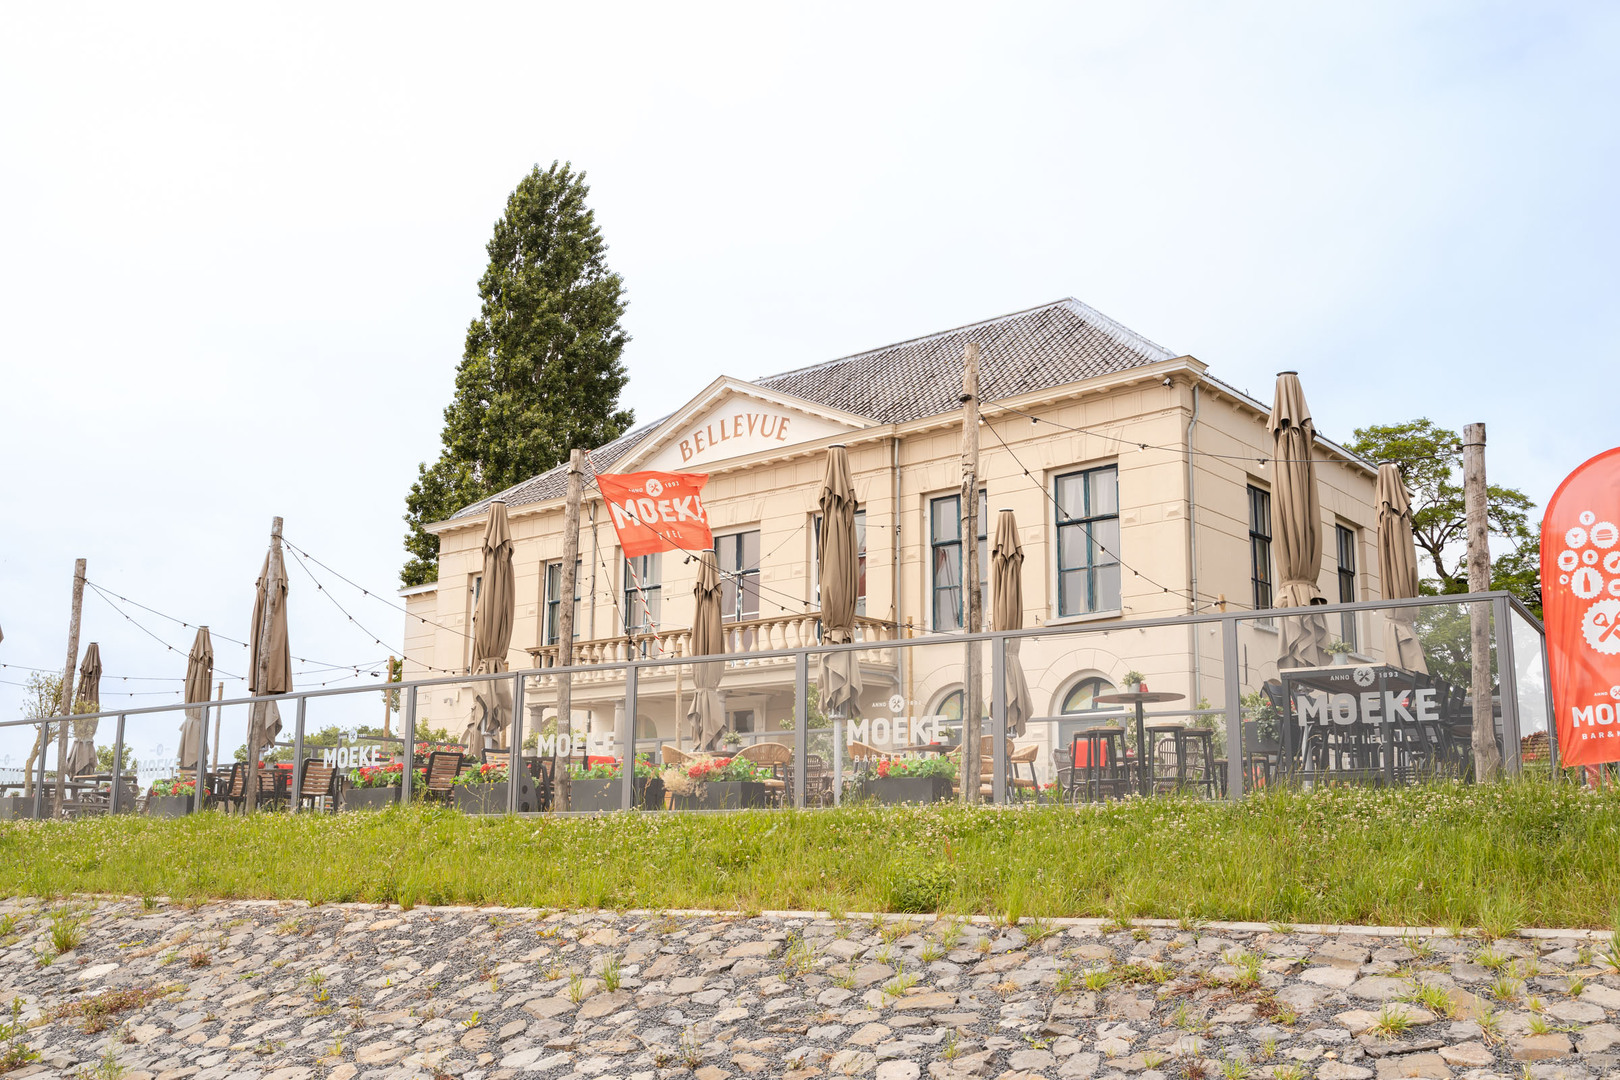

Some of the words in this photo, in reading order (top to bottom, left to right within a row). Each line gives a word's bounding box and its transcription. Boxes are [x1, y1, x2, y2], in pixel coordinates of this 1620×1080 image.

[679, 413, 791, 463] BELLEVUE
[1297, 688, 1439, 726] MOEKE
[1571, 702, 1620, 728] MO
[846, 714, 949, 746] MOEKE
[1349, 734, 1388, 745] TIEL
[323, 744, 382, 769] MOEKE
[536, 732, 617, 758] MOEKE
[136, 757, 181, 779] MOEKE
